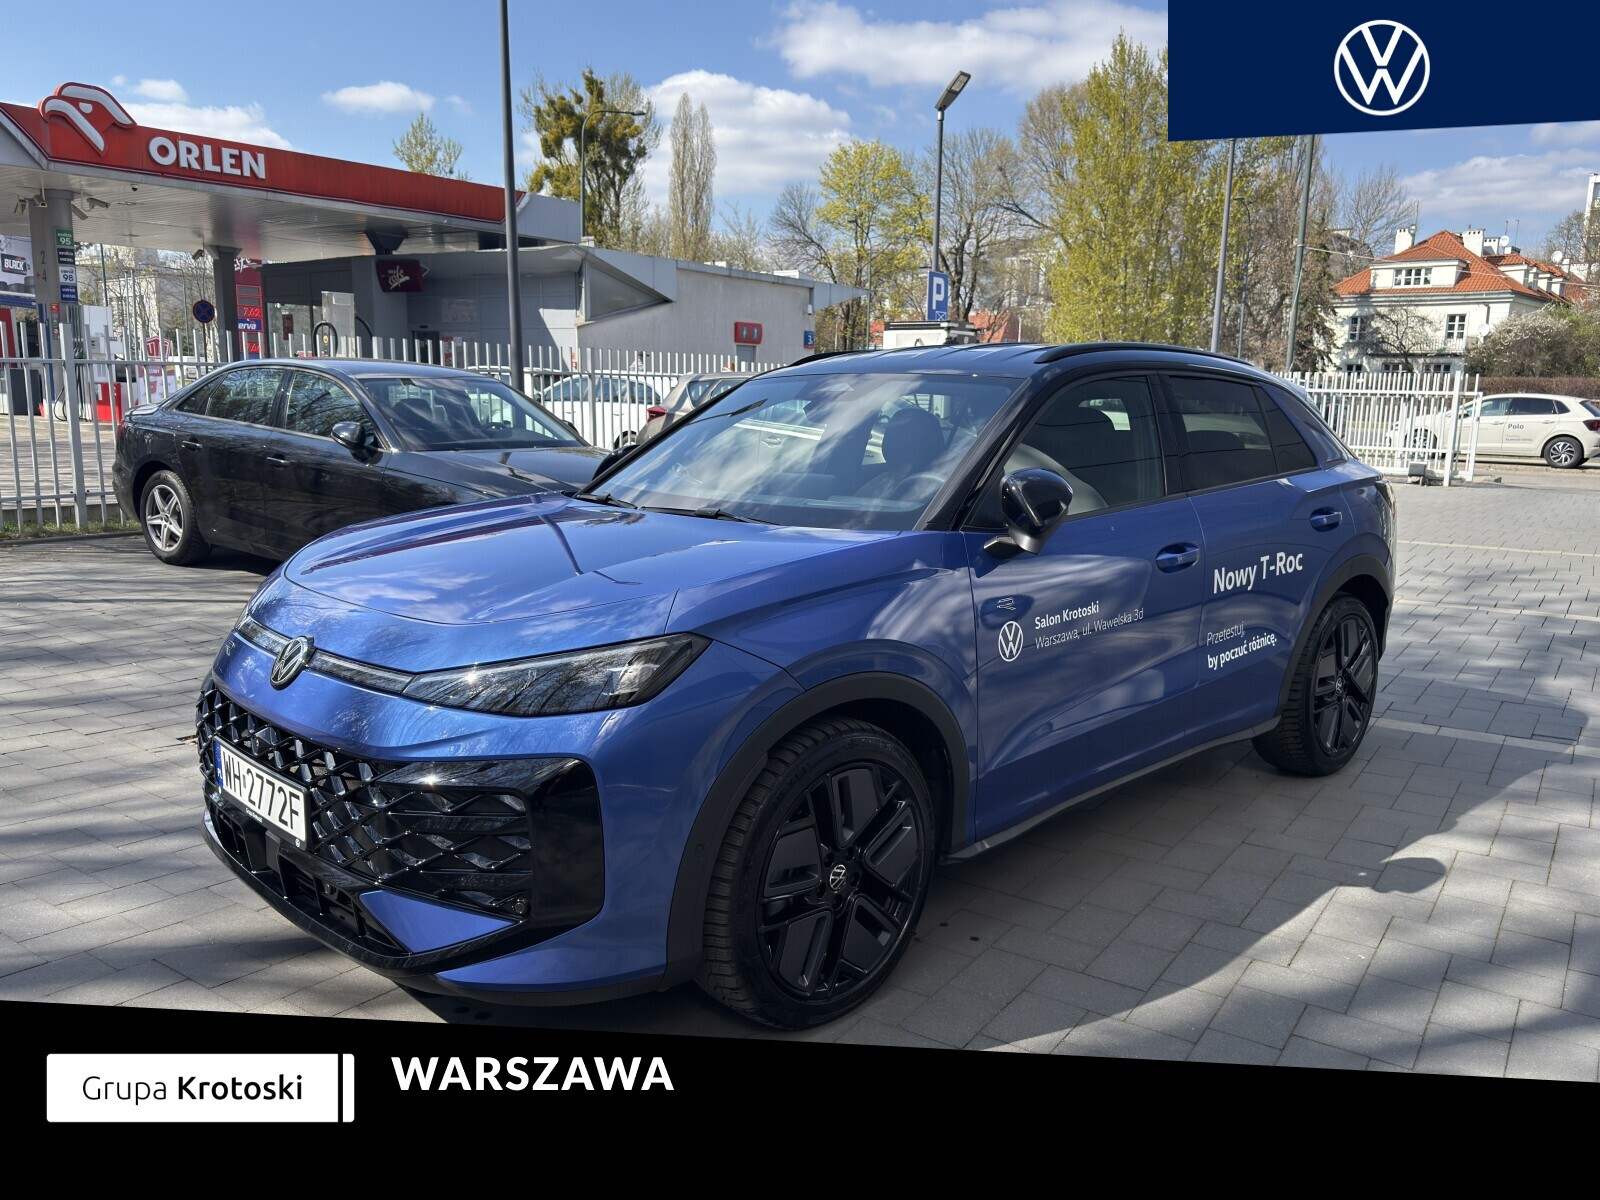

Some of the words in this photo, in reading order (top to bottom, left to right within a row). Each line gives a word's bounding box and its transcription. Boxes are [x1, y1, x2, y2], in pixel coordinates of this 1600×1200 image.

[149, 136, 266, 180] ORLEN
[60, 237, 71, 246] 95
[4, 259, 24, 271] BLACK
[62, 274, 74, 282] 98
[932, 276, 945, 310] P
[238, 322, 257, 330] erva
[1213, 564, 1257, 594] Nowy
[1260, 551, 1303, 580] T-Roc
[1035, 614, 1060, 630] Salon
[1063, 600, 1099, 622] Krotoski
[1035, 628, 1080, 649] Warszawa,
[1082, 622, 1092, 636] ul.
[1093, 613, 1132, 632] Wawelska
[1134, 607, 1144, 621] 3d
[1207, 653, 1218, 670] by
[1220, 640, 1247, 667] poczuć
[1248, 632, 1277, 653] różnicę.
[222, 750, 242, 798] WH
[246, 767, 300, 830] 2772F
